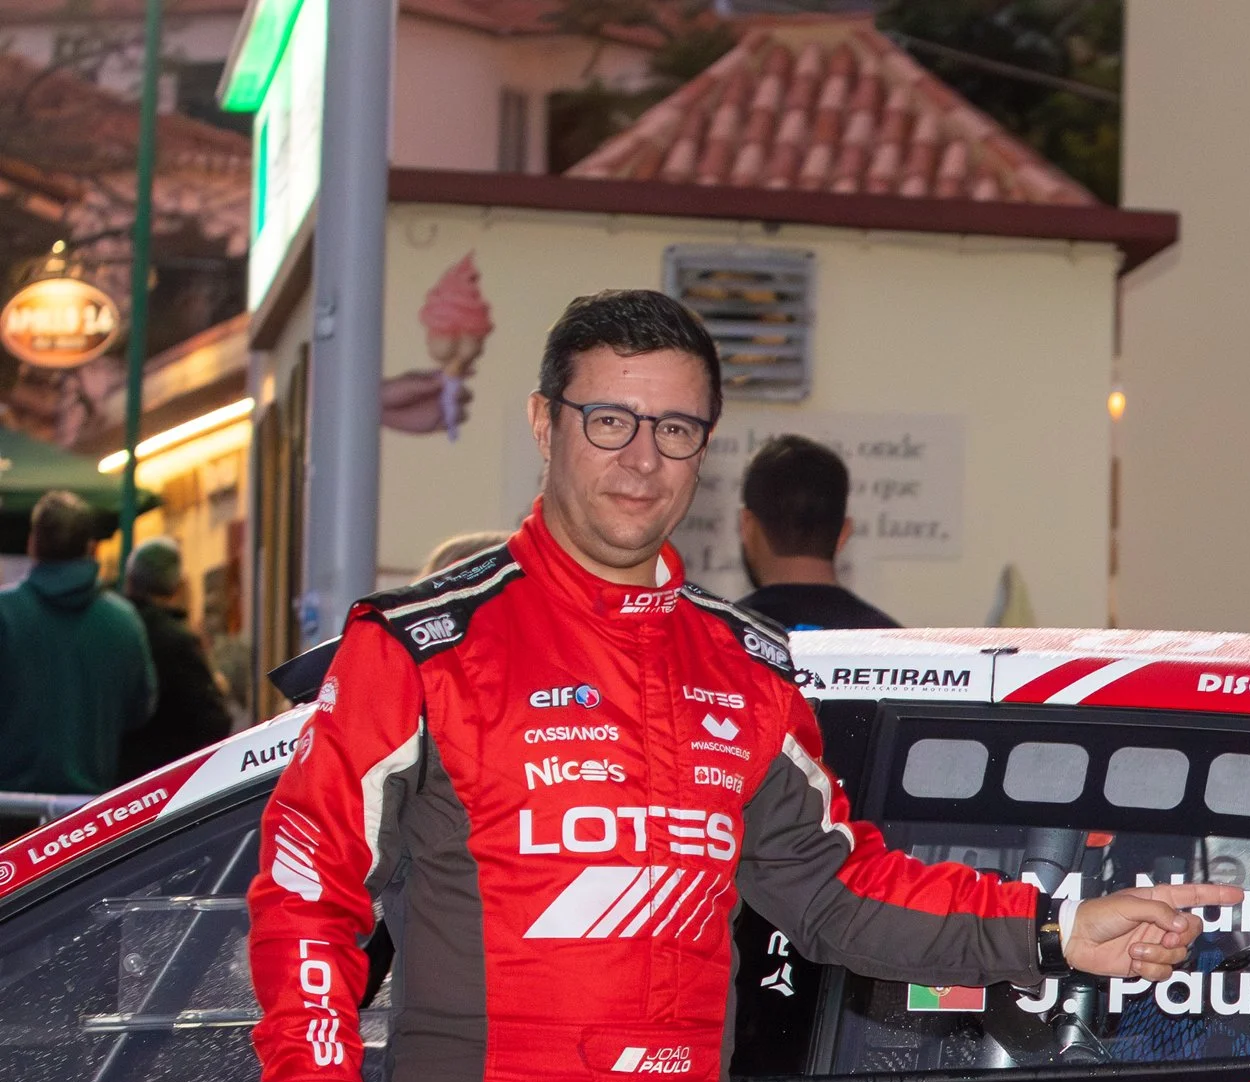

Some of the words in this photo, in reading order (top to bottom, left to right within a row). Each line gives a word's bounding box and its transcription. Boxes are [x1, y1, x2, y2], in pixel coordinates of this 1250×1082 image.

[409, 616, 456, 646] OMP
[743, 633, 789, 665] OMP
[831, 668, 971, 687] RETIRAM
[529, 685, 577, 709] elf
[682, 685, 746, 710] LOTES
[523, 724, 621, 744] CASSIANO'S
[690, 741, 751, 761] MVASCONCELOS
[709, 766, 742, 794] Diera
[26, 820, 98, 865] Lotes
[96, 787, 169, 828] Team
[519, 804, 737, 861] LOTES
[299, 938, 344, 1067] LOTES
[646, 1045, 691, 1061] JOÃO
[638, 1060, 692, 1074] PAULO
